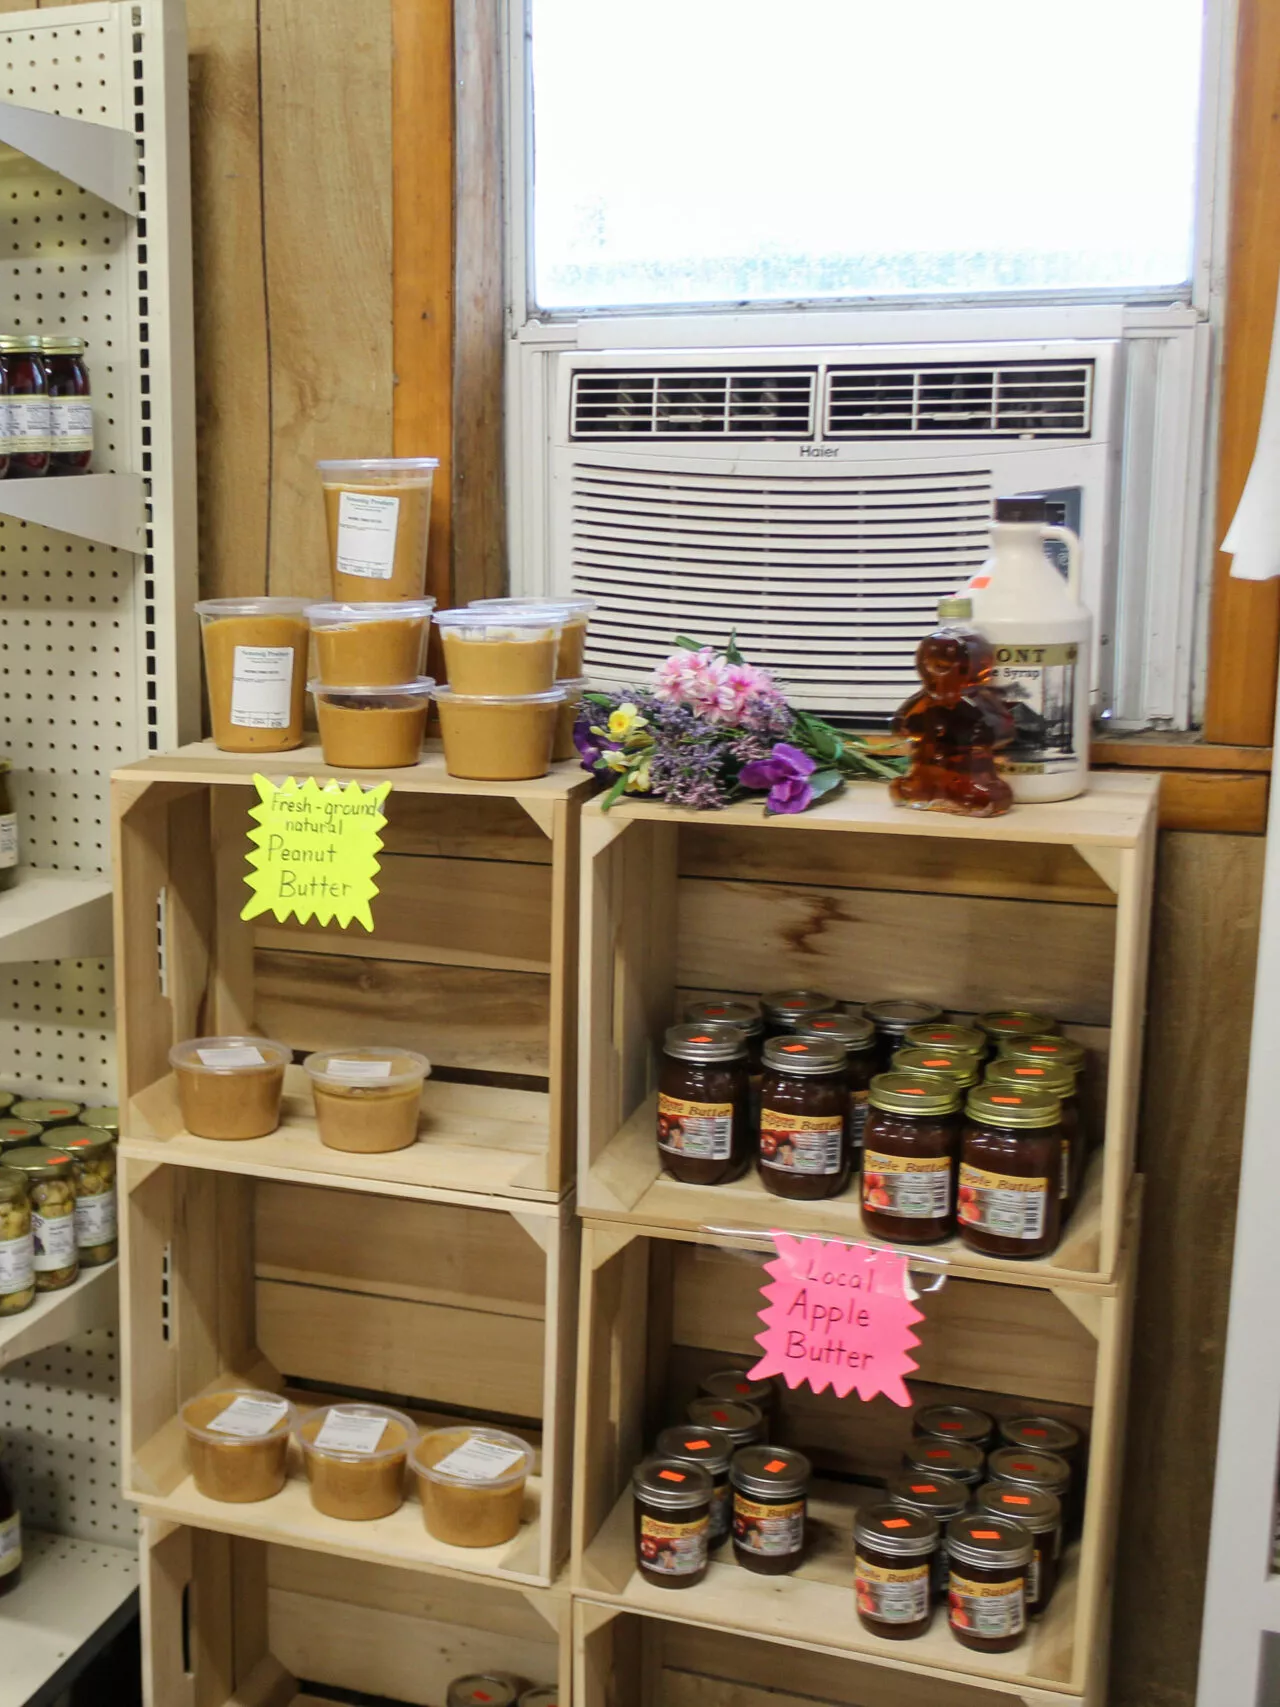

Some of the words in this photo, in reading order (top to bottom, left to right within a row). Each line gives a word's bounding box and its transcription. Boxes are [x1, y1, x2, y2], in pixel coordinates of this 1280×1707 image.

[800, 446, 839, 457] Haier
[996, 648, 1047, 663] ONT
[1003, 667, 1040, 680] Syrup
[285, 819, 343, 836] natural
[267, 834, 337, 862] Peanut
[278, 870, 352, 898] Butter
[904, 1162, 950, 1173] Butter
[997, 1180, 1045, 1193] Butter
[806, 1259, 875, 1292] Local
[786, 1288, 871, 1335] Apple
[785, 1330, 874, 1370] Butter
